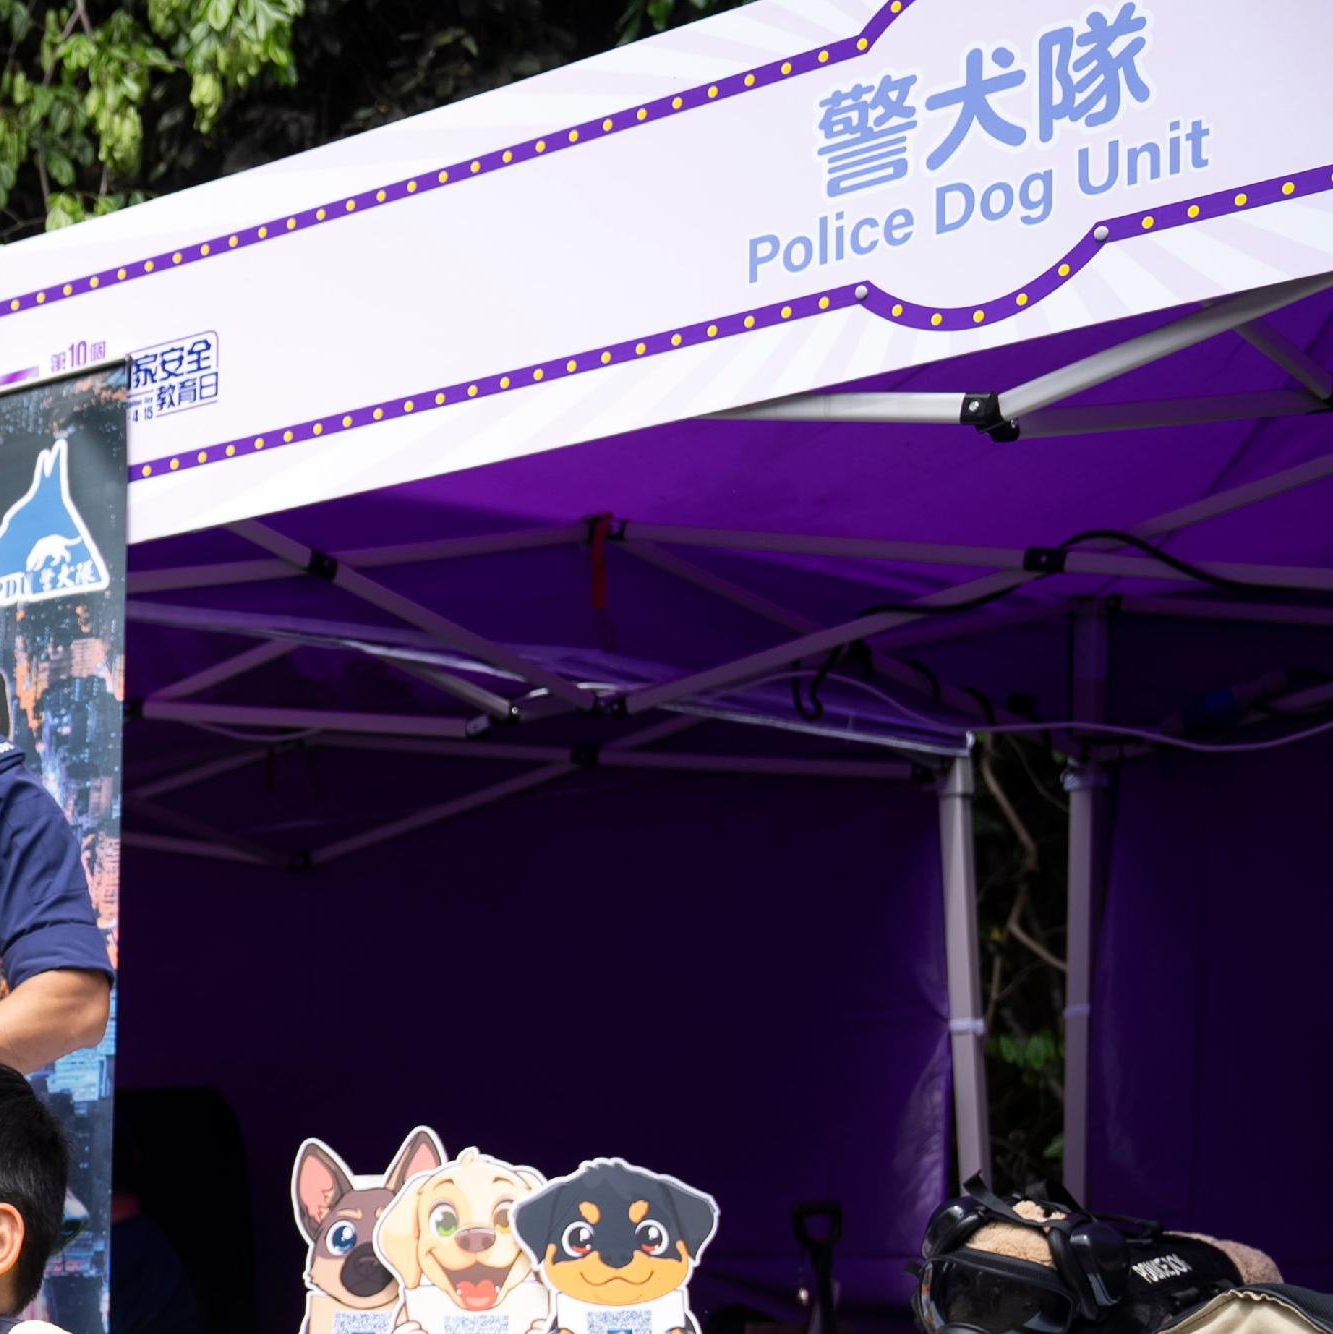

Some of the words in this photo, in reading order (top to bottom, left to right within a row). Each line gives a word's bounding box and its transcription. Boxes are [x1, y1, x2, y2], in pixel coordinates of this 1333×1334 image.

[818, 2, 1150, 197] 警犬隊
[748, 207, 915, 283] Police
[935, 169, 1053, 235] Dog
[1078, 119, 1210, 195] Unit
[128, 338, 212, 389] 家安全
[157, 371, 219, 411] 教育日
